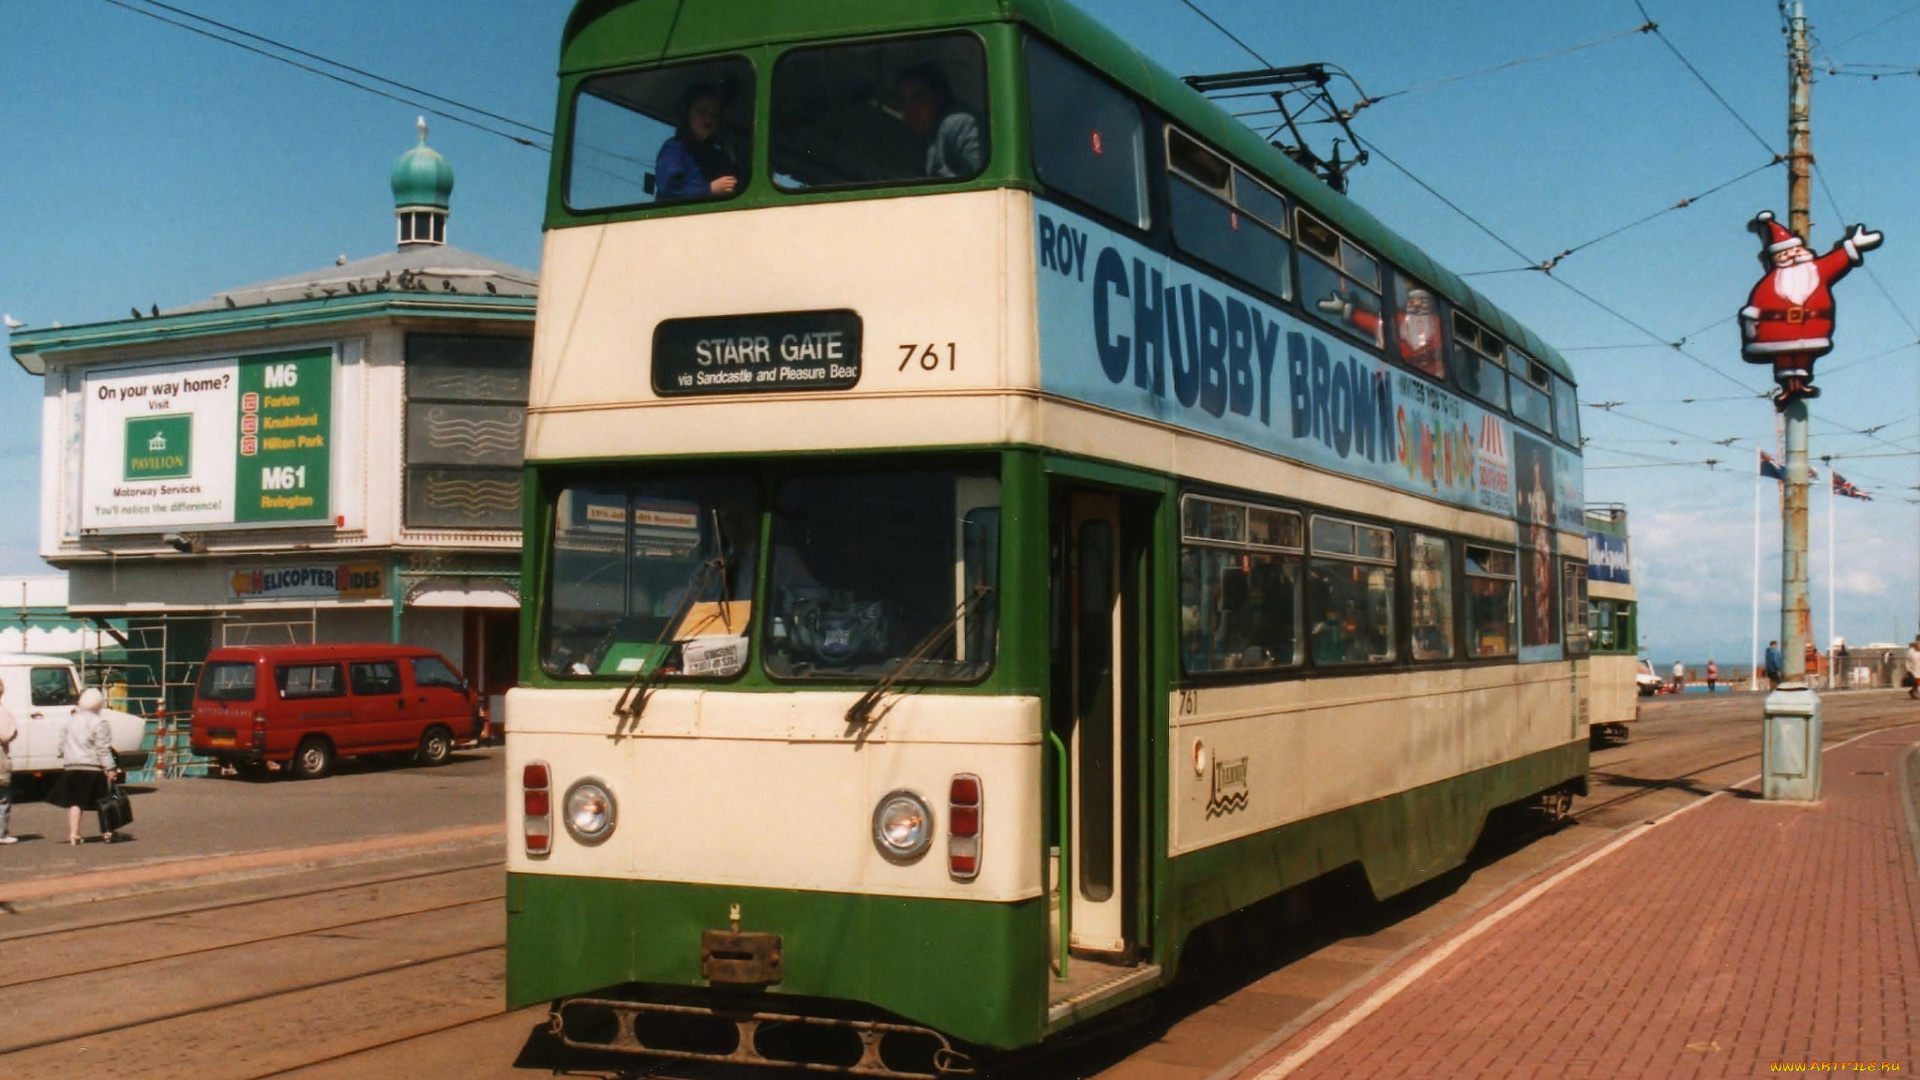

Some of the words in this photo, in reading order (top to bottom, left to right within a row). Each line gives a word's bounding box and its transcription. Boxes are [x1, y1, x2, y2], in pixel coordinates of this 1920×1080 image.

[696, 335, 770, 366] STARR
[780, 332, 843, 362] GATE
[1039, 214, 1087, 282] ROY
[1093, 247, 1280, 427] CHUBBY
[1287, 331, 1397, 464] BROWN
[898, 342, 956, 372] 761
[98, 386, 116, 400] On
[120, 386, 147, 401] your
[152, 382, 179, 397] way
[183, 374, 230, 393] home?
[264, 364, 298, 388] M6
[678, 374, 693, 387] via
[696, 369, 753, 386] Sandcastle
[756, 367, 777, 382] and
[780, 366, 826, 381] Pleasure
[149, 400, 169, 410] Visit
[298, 435, 324, 448] Park
[131, 456, 184, 471] PAVILION
[261, 465, 306, 490] M61
[113, 487, 157, 498] Motorway
[161, 485, 201, 495] Services
[95, 505, 119, 515] You'll
[122, 505, 150, 514] notice
[153, 503, 167, 512] the
[170, 500, 222, 511] difference!
[252, 568, 334, 594] HELICOPTER
[335, 565, 380, 590] RIDES
[1179, 690, 1197, 715] 761
